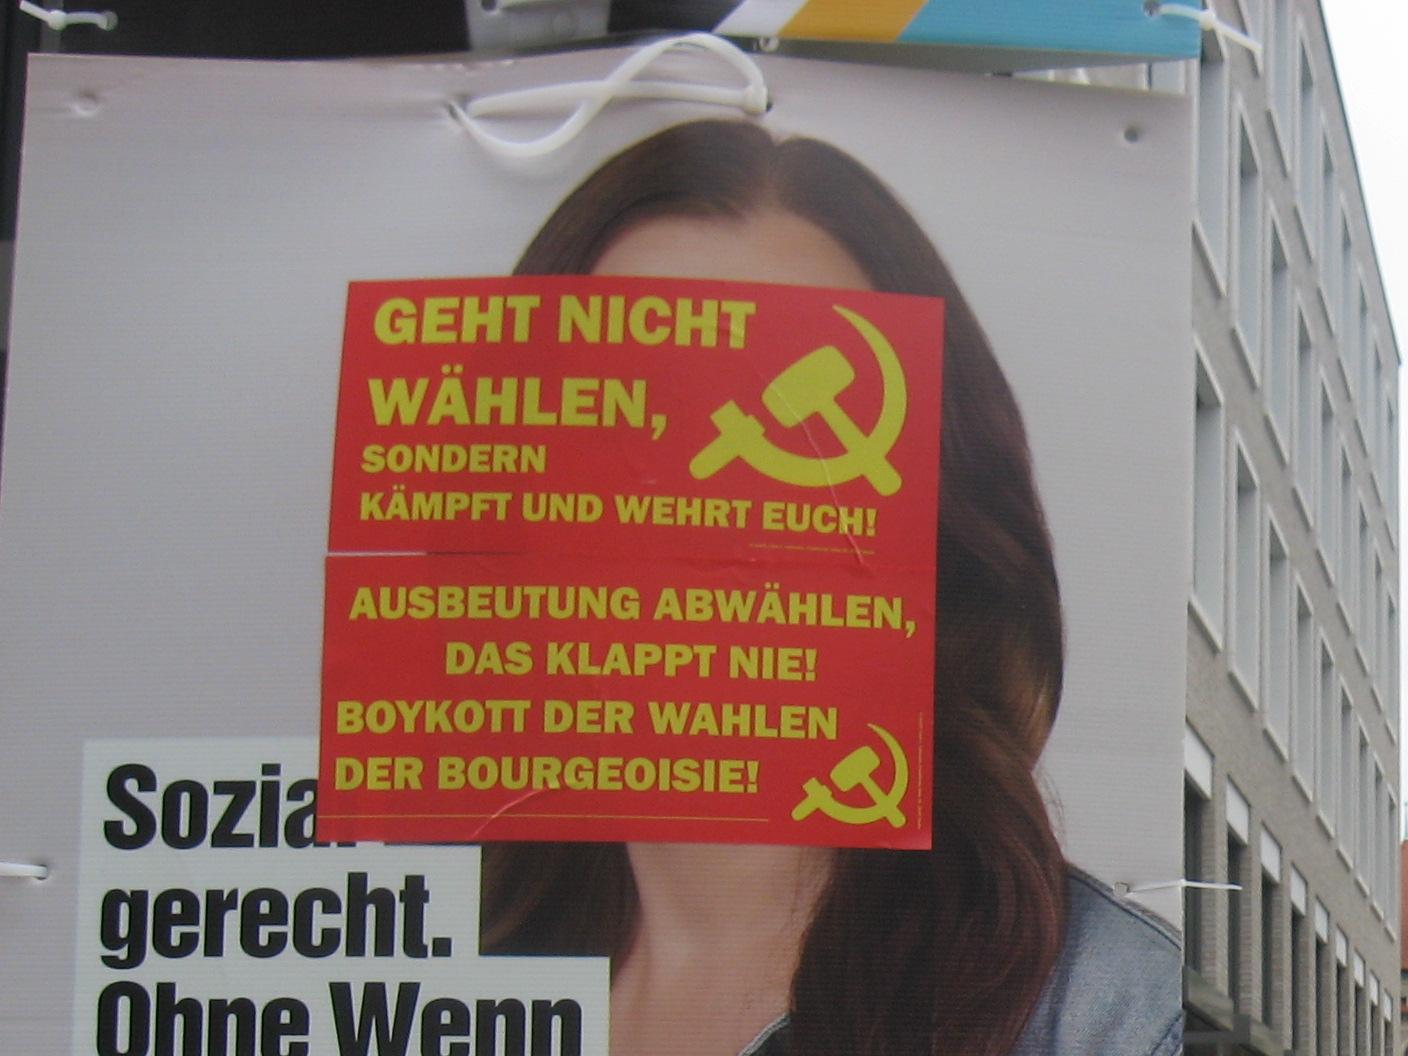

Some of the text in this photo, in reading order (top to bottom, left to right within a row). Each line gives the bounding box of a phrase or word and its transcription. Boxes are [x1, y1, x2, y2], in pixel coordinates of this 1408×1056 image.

[373, 294, 756, 349] GEHT NICHT
[368, 364, 667, 441] WÄHLEN,
[361, 443, 547, 473] SONDERN
[359, 484, 878, 536] KÄMPFT UND WEHRT EUCH!
[349, 583, 917, 637] AUSBEUTUNG ABWÄHLEN,
[445, 641, 818, 681] DAS KLAPPT NIE!
[336, 699, 838, 740] BOYKOTT DER WAHLEN
[334, 756, 760, 793] DER BOURGEOISIE!
[104, 763, 356, 850] Sozia
[100, 871, 452, 970] gerecht.
